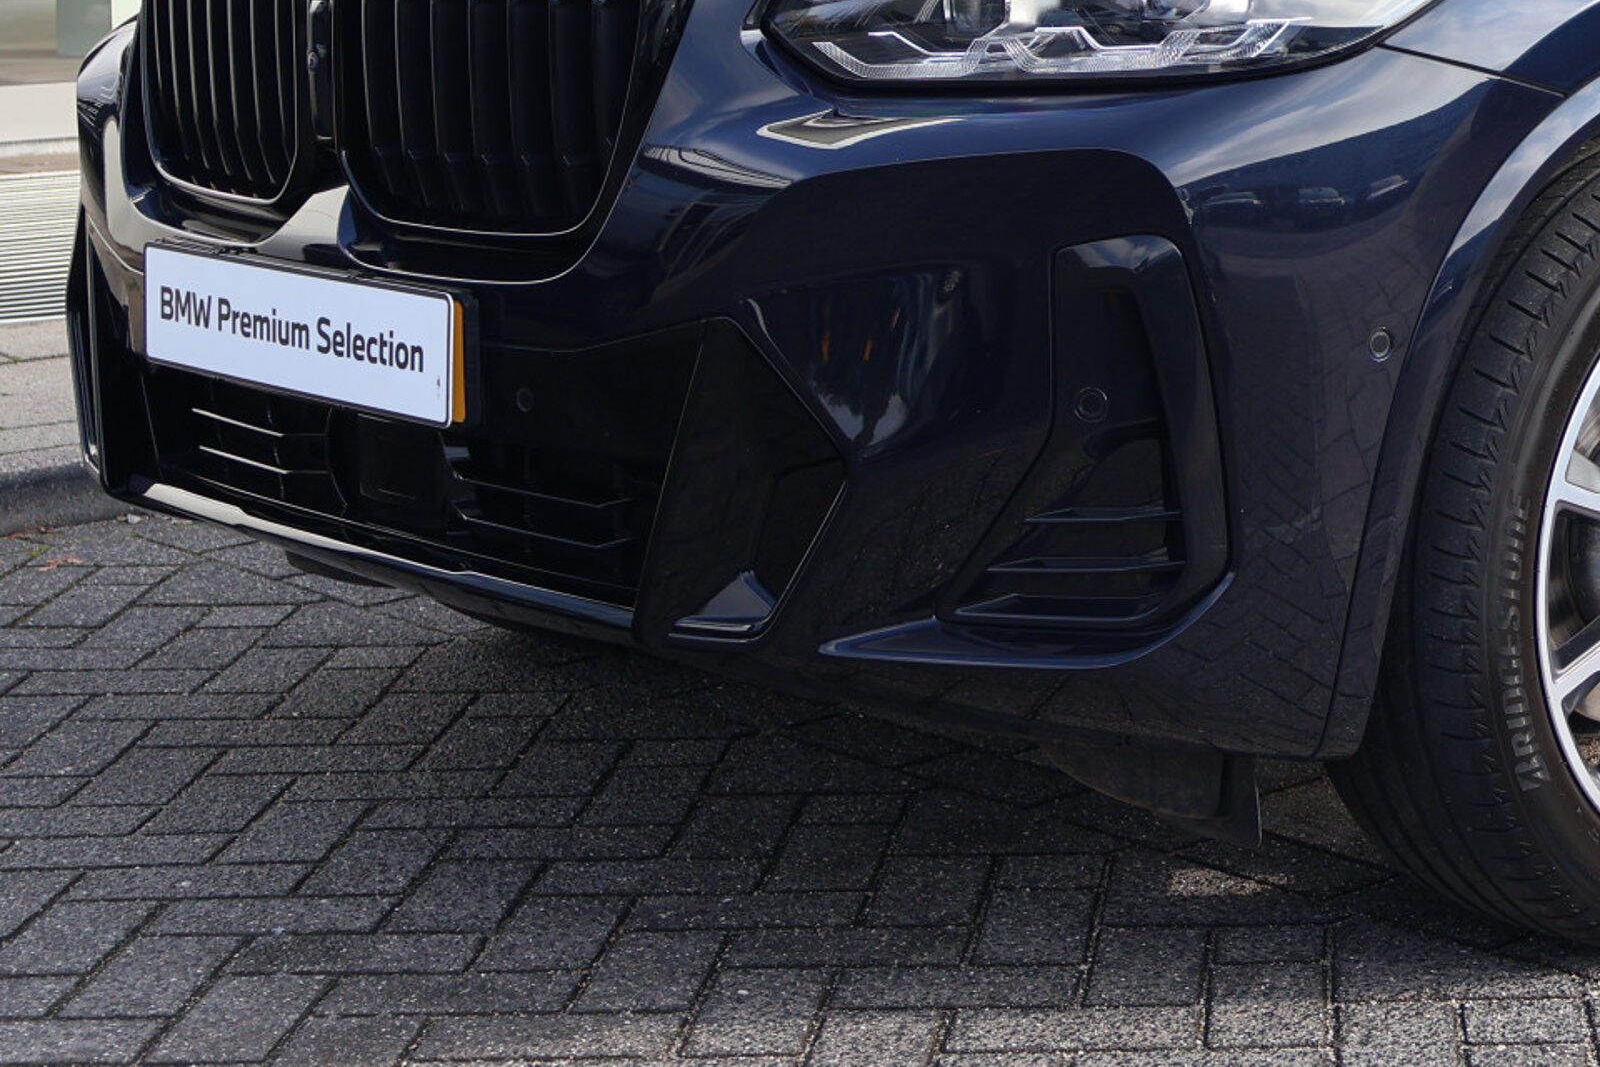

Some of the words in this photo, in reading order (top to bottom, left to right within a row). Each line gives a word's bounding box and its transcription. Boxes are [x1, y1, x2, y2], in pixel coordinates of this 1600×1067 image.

[160, 286, 212, 329] BMW
[218, 298, 310, 350] Premium
[316, 317, 425, 372] Selection
